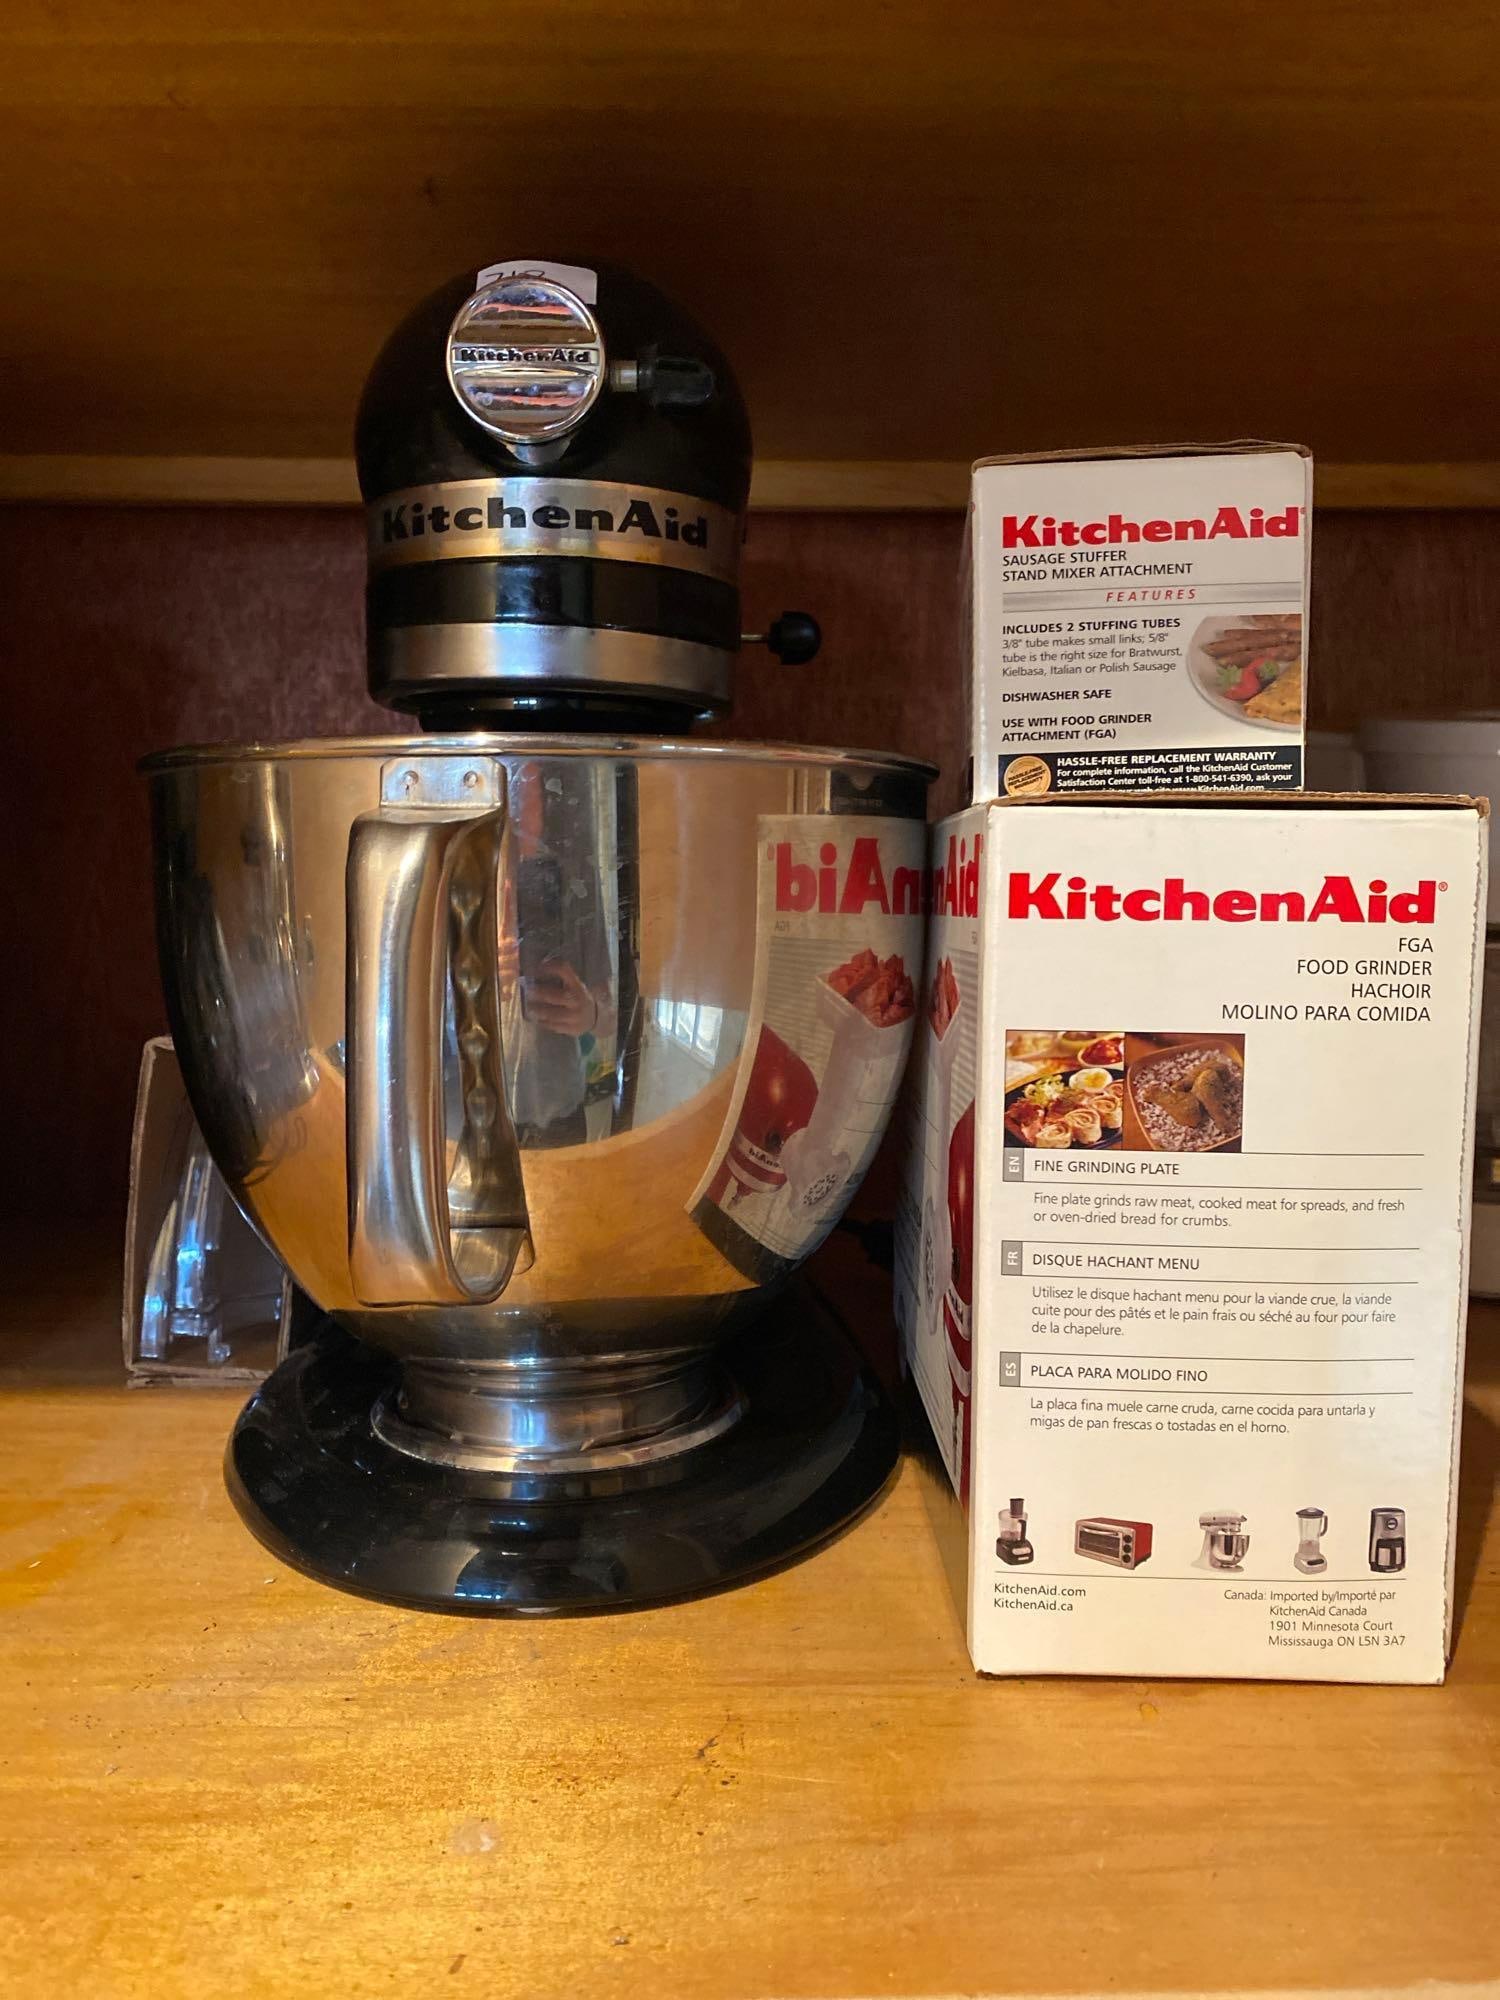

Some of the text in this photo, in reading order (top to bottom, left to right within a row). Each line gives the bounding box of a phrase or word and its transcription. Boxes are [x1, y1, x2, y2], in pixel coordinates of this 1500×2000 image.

[461, 348, 590, 362] KitchenAid
[382, 496, 709, 549] KitchenAid
[1002, 549, 1127, 567] SAUSAGE STUFFER
[1002, 562, 1193, 582] STAND MIXER ATTACHMENT
[1106, 588, 1196, 602] FEATURES
[1002, 617, 1181, 635] INCLUDES 2 STUFFING TUBES
[1024, 637, 1050, 648] tube
[1051, 636, 1086, 647] makes
[1088, 633, 1116, 646] small
[1001, 652, 1027, 663] tube
[1029, 651, 1037, 662] is
[1039, 650, 1058, 662] the
[1060, 649, 1085, 663] right
[1087, 649, 1108, 660] size
[1110, 647, 1126, 658] for
[1049, 664, 1082, 675] Italian
[1084, 665, 1097, 674] or
[1099, 661, 1130, 673] Polish
[1132, 661, 1177, 673] Sausage
[1002, 688, 1112, 703] DISHWASHER SAFE
[1002, 713, 1152, 728] USE WITH FOOD GRINDER
[1001, 728, 1116, 742] ATTACHMENT (FGA)
[1057, 751, 1277, 766] HASSLE-FREE REPLACEMENT WARRANTY
[1056, 768, 1071, 777] For
[1072, 767, 1113, 777] complete
[1168, 765, 1184, 773] call
[1185, 764, 1201, 773] the
[1202, 763, 1249, 772] KitchenAid
[1250, 763, 1293, 773] Customer
[1056, 777, 1106, 787] Satisfaction
[1107, 777, 1136, 786] Center
[1137, 776, 1172, 785] toll-free
[1173, 775, 1183, 784] at
[1255, 772, 1271, 781] ask
[1271, 774, 1293, 783] your
[1398, 937, 1434, 953] FGA
[1297, 959, 1432, 976] FOOD GRINDER
[1351, 982, 1431, 999] HACHOIR
[1222, 1004, 1431, 1022] MOLINO PARA COMIDA
[1009, 1156, 1020, 1173] EN
[1034, 1159, 1180, 1175] FINE GRINDING PLATE
[1033, 1191, 1058, 1205] Fine
[1061, 1192, 1091, 1207] plate
[1093, 1193, 1131, 1209] grinds
[1134, 1197, 1158, 1207] raw
[1198, 1196, 1242, 1210] cooked
[1245, 1199, 1277, 1210] meat
[1279, 1197, 1298, 1211] for
[1351, 1198, 1374, 1211] and
[1377, 1198, 1405, 1211] fresh
[1007, 1250, 1018, 1266] FR
[1032, 1253, 1199, 1270] DISQUE HACHANT MENU
[1032, 1285, 1074, 1299] Utilisez
[1076, 1286, 1088, 1300] le
[1089, 1287, 1130, 1303] disque
[1132, 1288, 1182, 1302] hachant
[1184, 1293, 1219, 1303] menu
[1222, 1294, 1252, 1306] pour
[1254, 1291, 1265, 1305] la
[1267, 1292, 1308, 1305] viande
[1342, 1292, 1352, 1305] la
[1354, 1292, 1392, 1305] viande
[1031, 1304, 1396, 1325] cuite pour des pâtés et le pain frais ou séché au four pour faire
[1005, 1361, 1017, 1378] ES
[1030, 1364, 1208, 1382] PLACA PARA MOLIDO FINO
[1030, 1397, 1043, 1409] La
[1046, 1397, 1077, 1412] placa
[1080, 1398, 1103, 1411] fina
[1106, 1400, 1143, 1413] muele
[1145, 1403, 1179, 1414] carne
[1221, 1405, 1254, 1415] carne
[1256, 1403, 1294, 1416] cocida
[1297, 1407, 1324, 1419] para
[1326, 1403, 1366, 1416] untarla
[1368, 1406, 1375, 1418] y
[1030, 1415, 1065, 1430] migas
[1067, 1416, 1084, 1428] de
[1086, 1419, 1109, 1431] pan
[1112, 1417, 1152, 1431] frescas
[1155, 1421, 1164, 1431] o
[1166, 1419, 1216, 1432] tostadas
[1218, 1423, 1234, 1432] en
[1237, 1420, 1247, 1433] el
[994, 1582, 1086, 1597] KitchenAid.com
[1270, 1589, 1319, 1603] Imported
[1321, 1589, 1377, 1604] by/Importé
[1379, 1591, 1396, 1603] par
[993, 1597, 1073, 1611] KitchenAid.ca
[1269, 1605, 1367, 1617] KitchenAid Canada
[1270, 1620, 1393, 1632] 1901 Minnesota Court
[1268, 1635, 1406, 1649] Mississauga ON L5N 3A7
